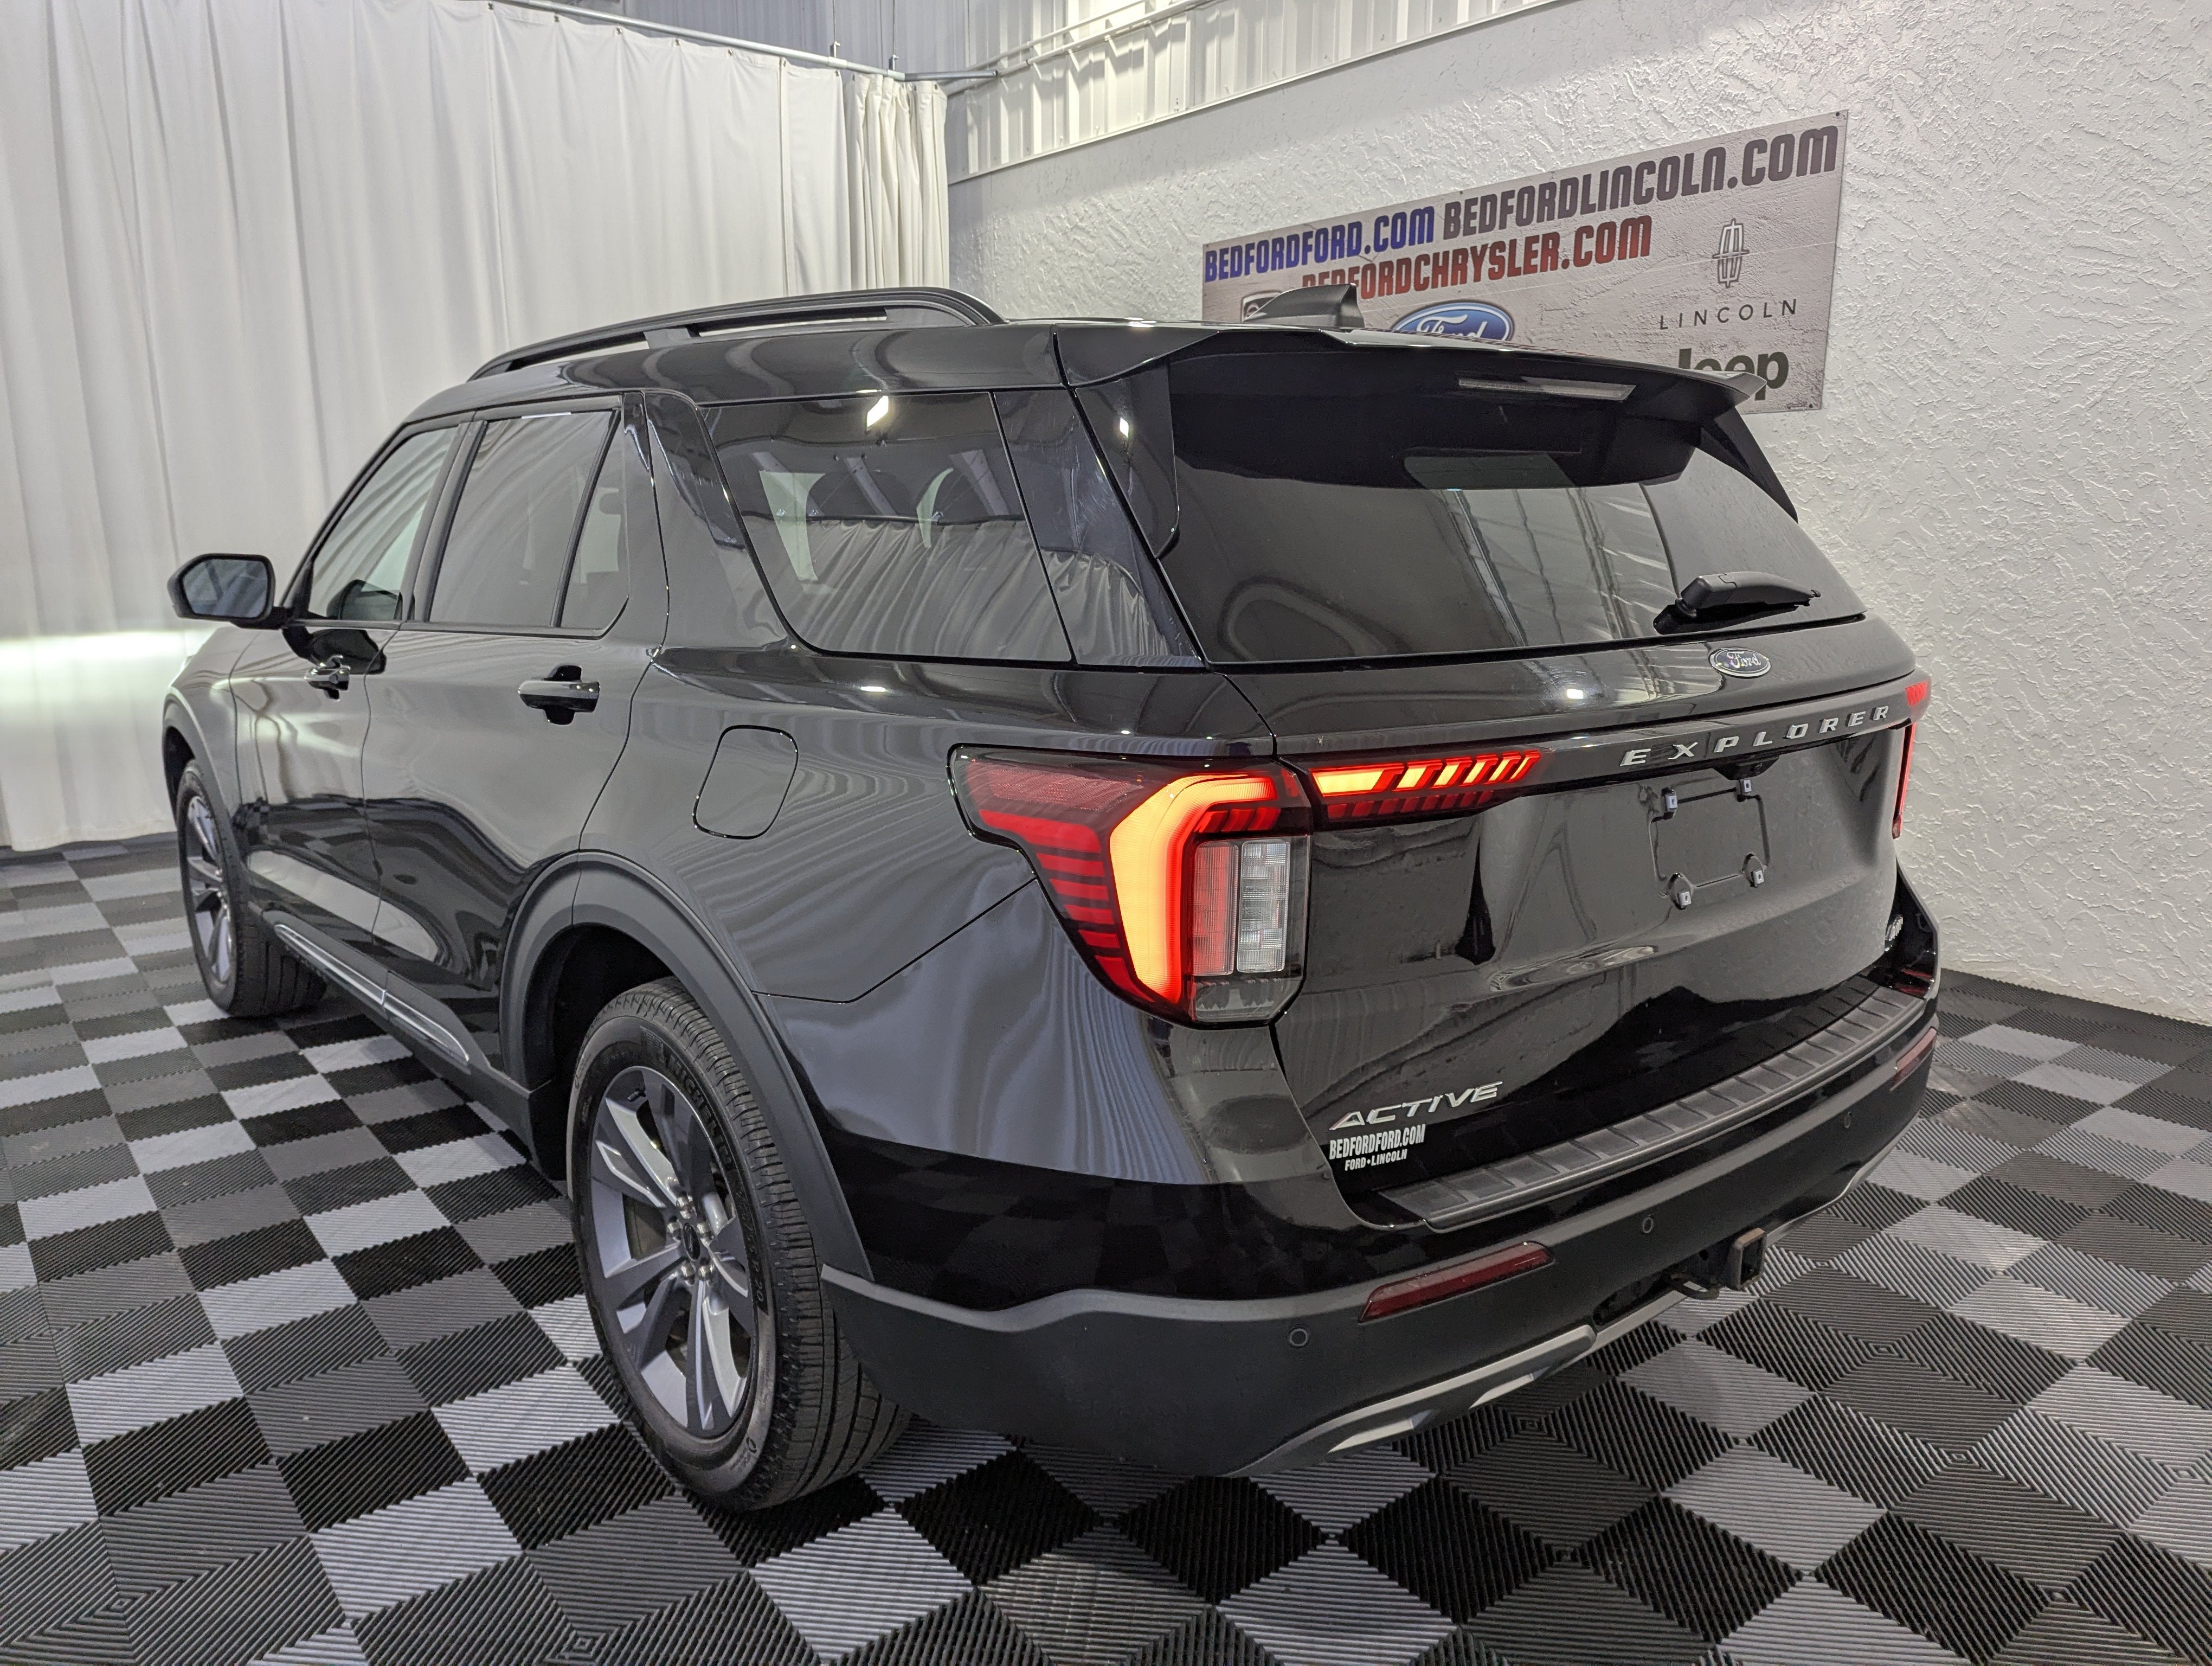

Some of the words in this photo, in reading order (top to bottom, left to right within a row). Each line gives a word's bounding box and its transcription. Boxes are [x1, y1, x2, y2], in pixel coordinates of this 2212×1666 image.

[1205, 206, 1435, 283] BEDFORDFORD.COM
[1443, 125, 1838, 240] BEDFORDLINCOLN.COM
[1660, 299, 1796, 330] LINCOLN
[1726, 651, 1761, 669] Ford
[1620, 706, 1889, 767] EXPLORER
[666, 1054, 732, 1165] MICHELIN
[1328, 1081, 1503, 1130] ACTIVE
[1329, 1124, 1426, 1160] BEDFORDFORD.COM
